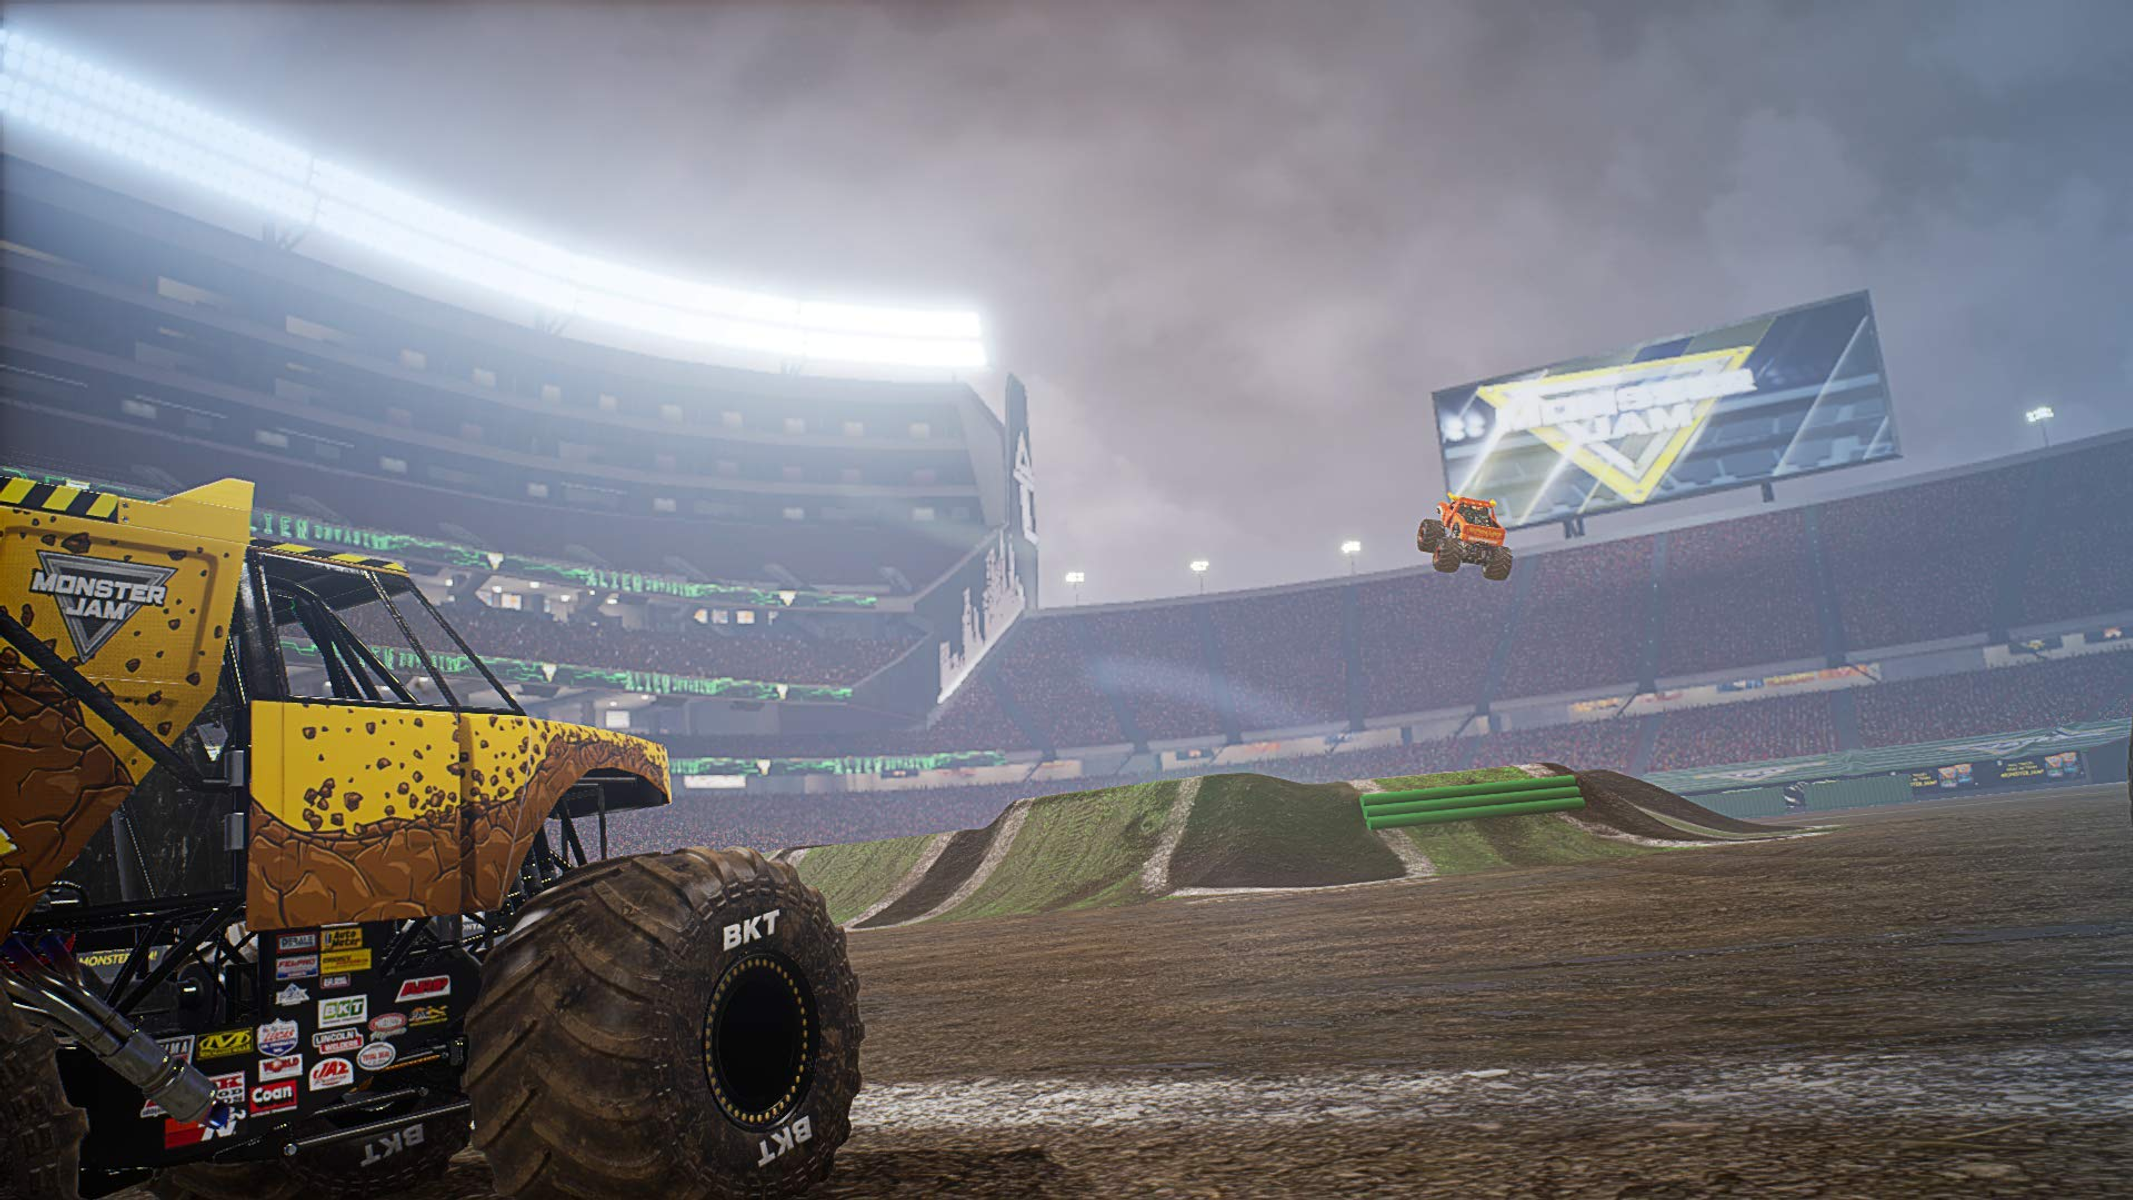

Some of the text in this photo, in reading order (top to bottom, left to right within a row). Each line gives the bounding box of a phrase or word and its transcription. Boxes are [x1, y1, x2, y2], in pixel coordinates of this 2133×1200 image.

[31, 571, 167, 605] MONSTER
[66, 597, 127, 620] JAM
[722, 909, 780, 951] BKT
[323, 999, 363, 1019] BKT
[315, 1031, 355, 1045] LINCOLN
[262, 1056, 300, 1074] WORLD
[251, 1085, 293, 1104] Coan
[360, 1122, 424, 1168] BKT
[758, 1115, 812, 1168] BKT
